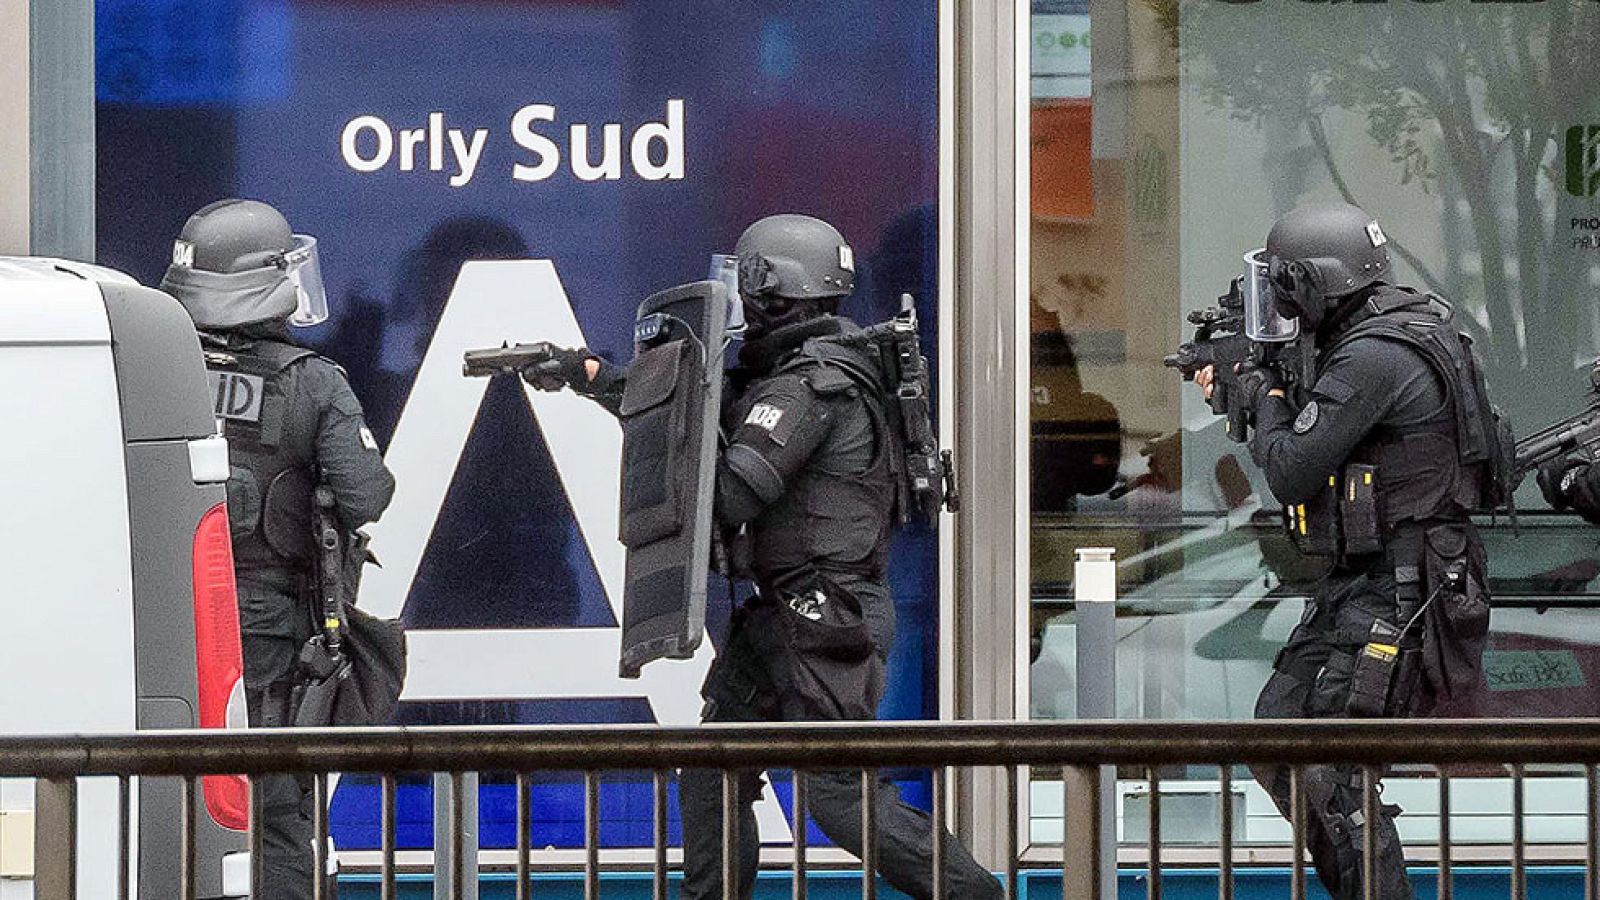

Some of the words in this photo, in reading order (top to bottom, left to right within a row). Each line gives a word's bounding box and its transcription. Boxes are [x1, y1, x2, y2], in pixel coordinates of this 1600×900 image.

[341, 111, 488, 187] Orly
[511, 99, 685, 181] Sud
[1571, 218, 1600, 230] PRO
